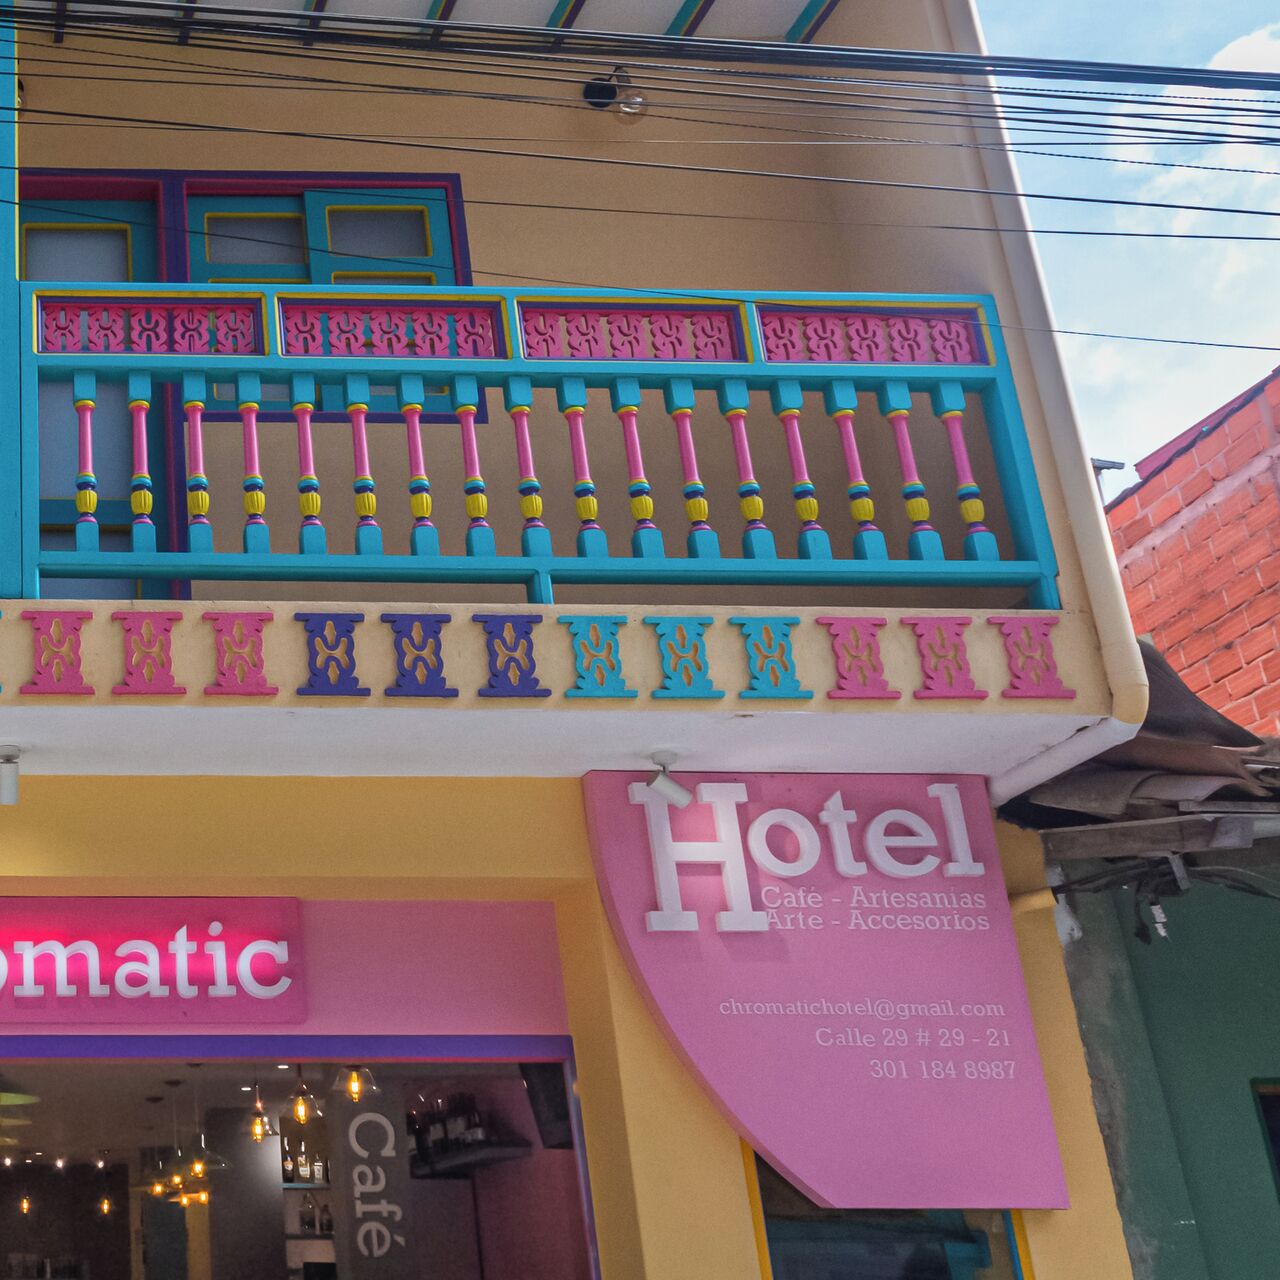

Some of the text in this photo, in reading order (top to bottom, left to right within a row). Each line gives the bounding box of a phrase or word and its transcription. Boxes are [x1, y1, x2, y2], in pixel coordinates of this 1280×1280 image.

[628, 782, 985, 932] Hotel
[761, 885, 824, 908] Café
[767, 910, 824, 930] Arte
[847, 910, 990, 931] Accesorios
[719, 998, 1006, 1020] chromatichotel@gmail.com
[815, 1027, 876, 1047] Calle
[882, 1028, 909, 1046] 29
[938, 1028, 965, 1047] 29
[986, 1028, 1010, 1047] 21
[870, 1060, 1016, 1080] 301 184 8987
[348, 1112, 406, 1258] Café
